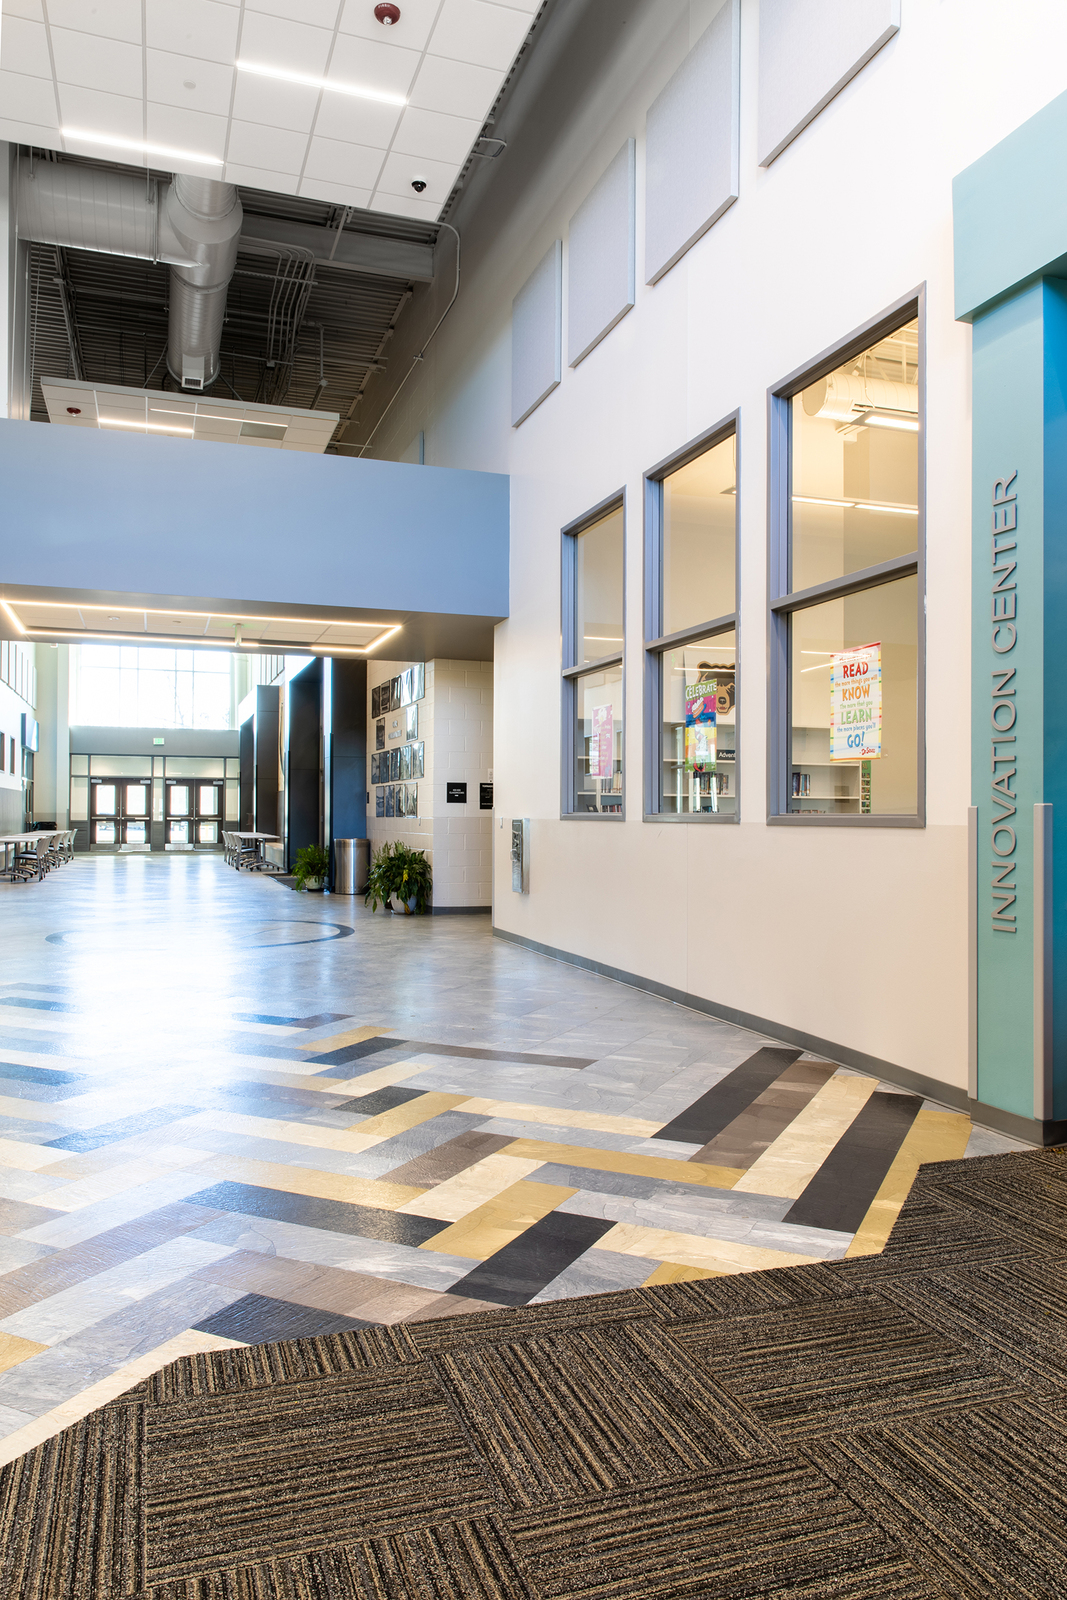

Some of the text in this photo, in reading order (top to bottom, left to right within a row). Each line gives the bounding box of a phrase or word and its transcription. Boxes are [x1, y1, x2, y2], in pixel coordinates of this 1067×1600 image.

[843, 661, 869, 678] READ
[685, 682, 717, 700] CELEBRATE
[842, 684, 870, 701] KNOW
[991, 469, 1017, 933] INNOVATION CENTER
[841, 708, 872, 725] LEARN
[847, 731, 865, 748] GO!
